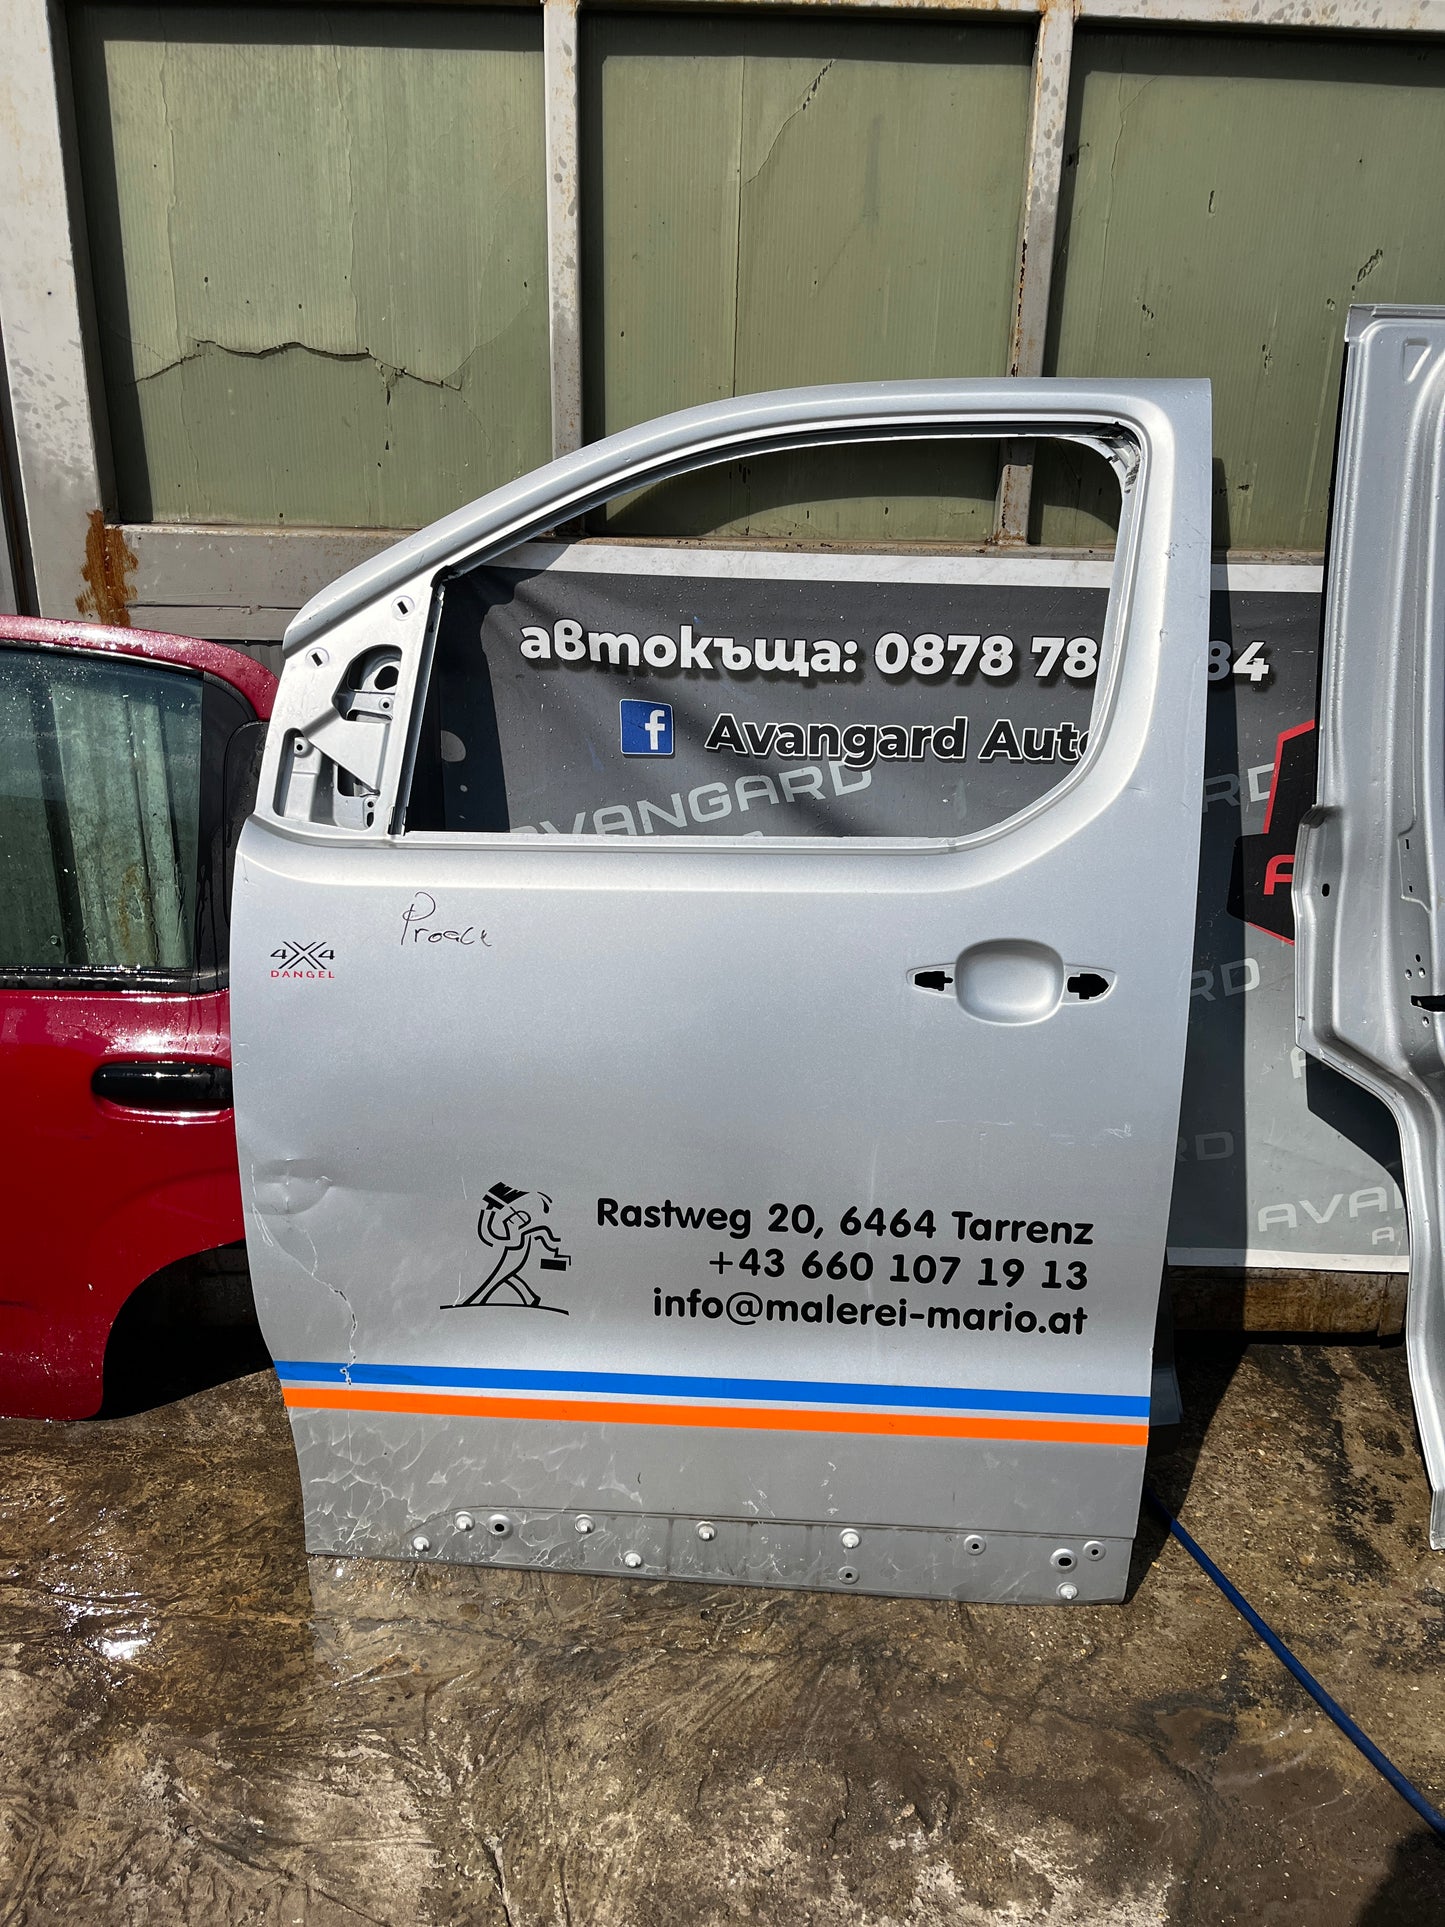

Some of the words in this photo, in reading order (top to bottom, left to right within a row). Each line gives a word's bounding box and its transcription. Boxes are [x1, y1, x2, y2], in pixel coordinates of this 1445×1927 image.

[520, 619, 858, 678] автокъща:
[874, 632, 1014, 678] 0878
[705, 713, 969, 767] Avangard
[510, 761, 872, 835] VANGARD
[270, 969, 336, 979] DANGEL
[597, 1197, 751, 1239] Rastweg
[768, 1203, 824, 1239] 20,
[839, 1206, 937, 1238] 6464
[951, 1211, 1094, 1244] Tarrenz
[709, 1248, 785, 1277] +43
[801, 1250, 874, 1281] 660
[889, 1254, 961, 1285] 107
[977, 1258, 1025, 1287] 19
[1041, 1261, 1088, 1290] 13
[653, 1286, 1088, 1335] info@malerei-mario.at
